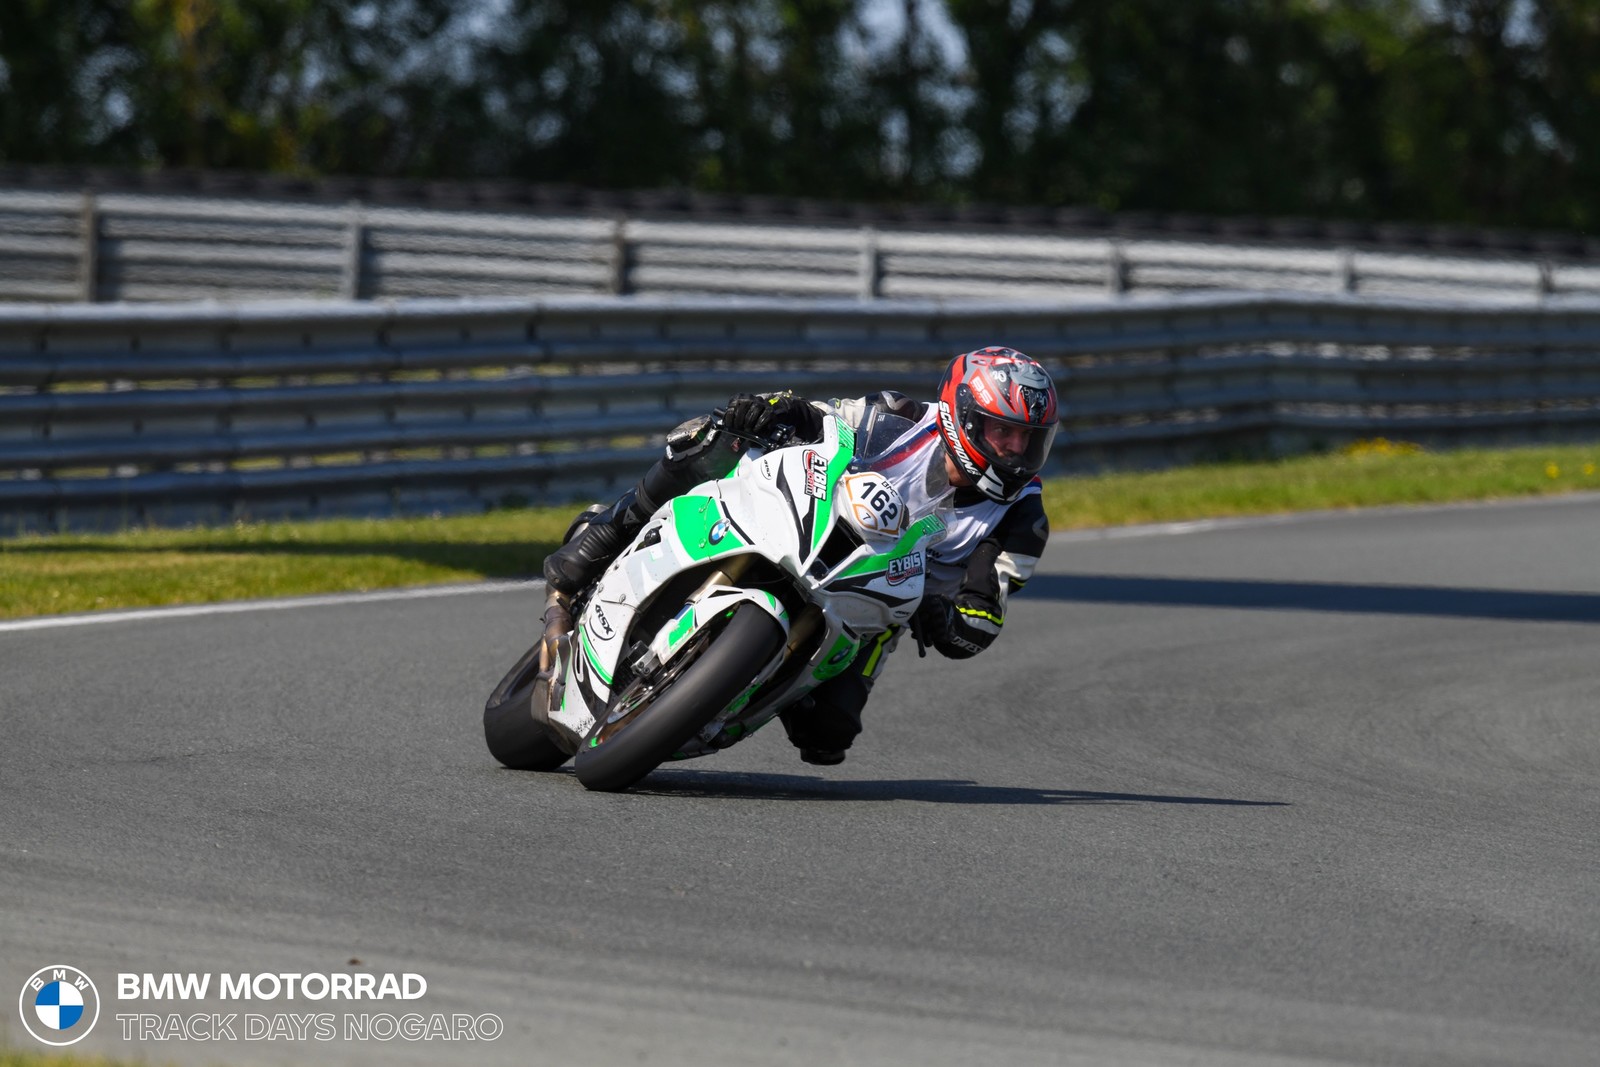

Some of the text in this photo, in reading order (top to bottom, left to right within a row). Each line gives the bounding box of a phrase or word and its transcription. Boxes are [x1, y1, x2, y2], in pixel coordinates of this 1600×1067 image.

[938, 400, 977, 476] SCORPION
[813, 455, 828, 501] EYBIS
[861, 481, 898, 527] 162
[862, 512, 871, 521] 7
[888, 552, 922, 573] EYBIS
